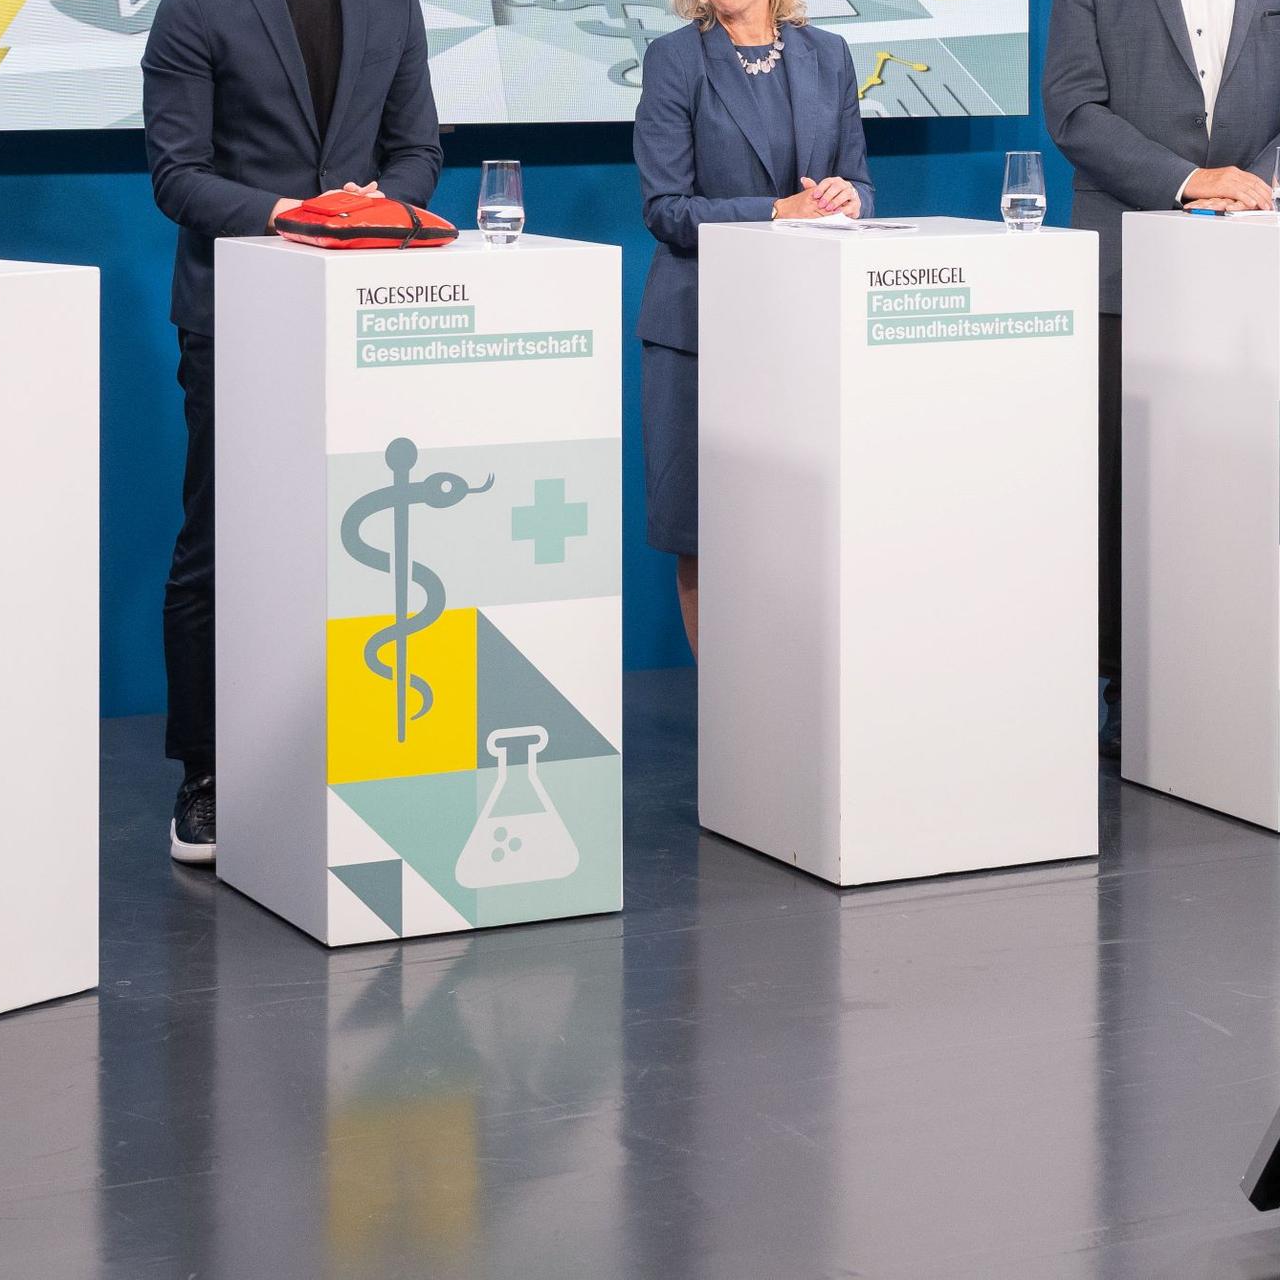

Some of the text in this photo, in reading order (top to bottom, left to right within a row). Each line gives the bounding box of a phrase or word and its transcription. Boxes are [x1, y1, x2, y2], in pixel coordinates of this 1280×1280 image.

[867, 267, 966, 287] TAGESSPIEGEL
[357, 284, 469, 305] TAGESSPIEGEL
[872, 293, 965, 312] Fachforum
[362, 312, 469, 332] Fachforum
[872, 315, 1068, 341] Gesundheitswirtschaft
[362, 335, 587, 362] Gesundheitswirtschaft
